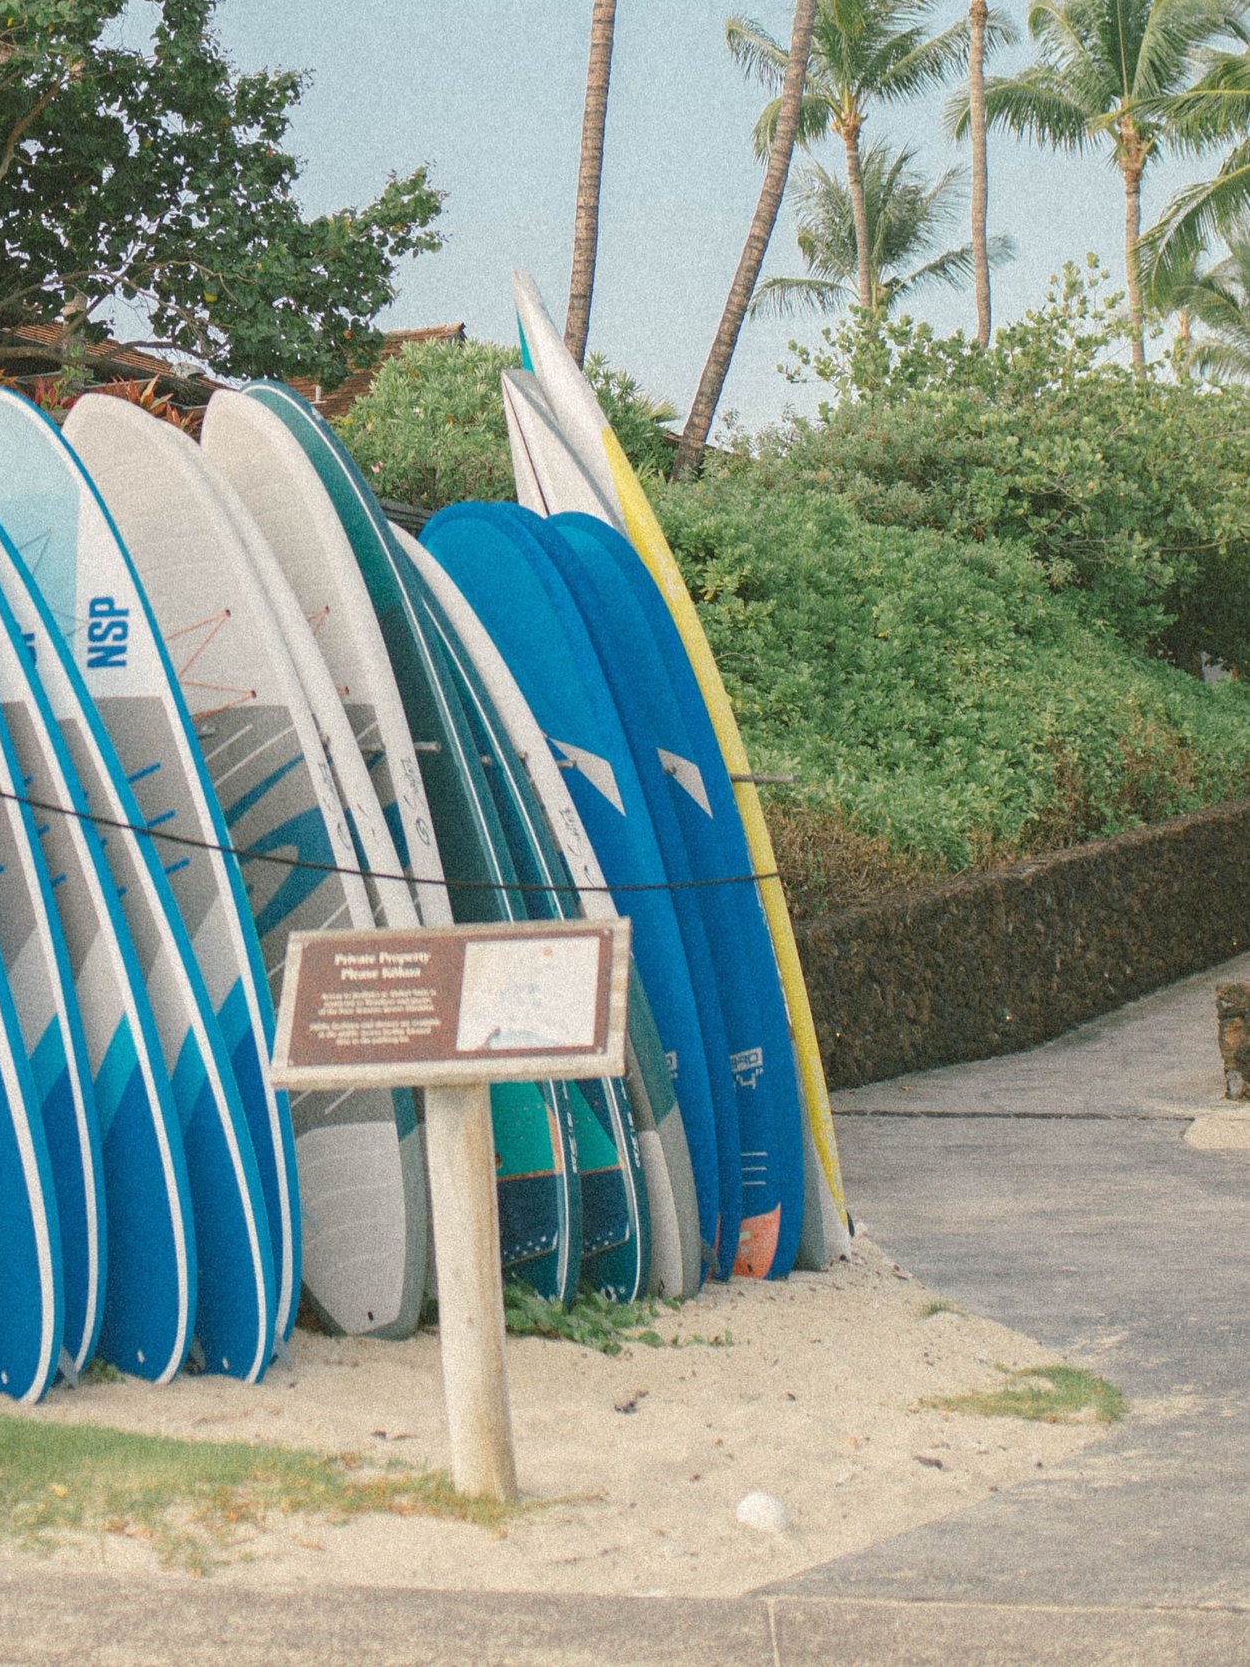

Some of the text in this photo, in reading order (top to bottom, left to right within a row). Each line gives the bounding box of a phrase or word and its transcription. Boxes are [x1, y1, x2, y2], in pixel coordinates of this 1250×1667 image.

[86, 597, 129, 668] NSP
[334, 951, 431, 966] Private Property
[341, 967, 379, 981] Please
